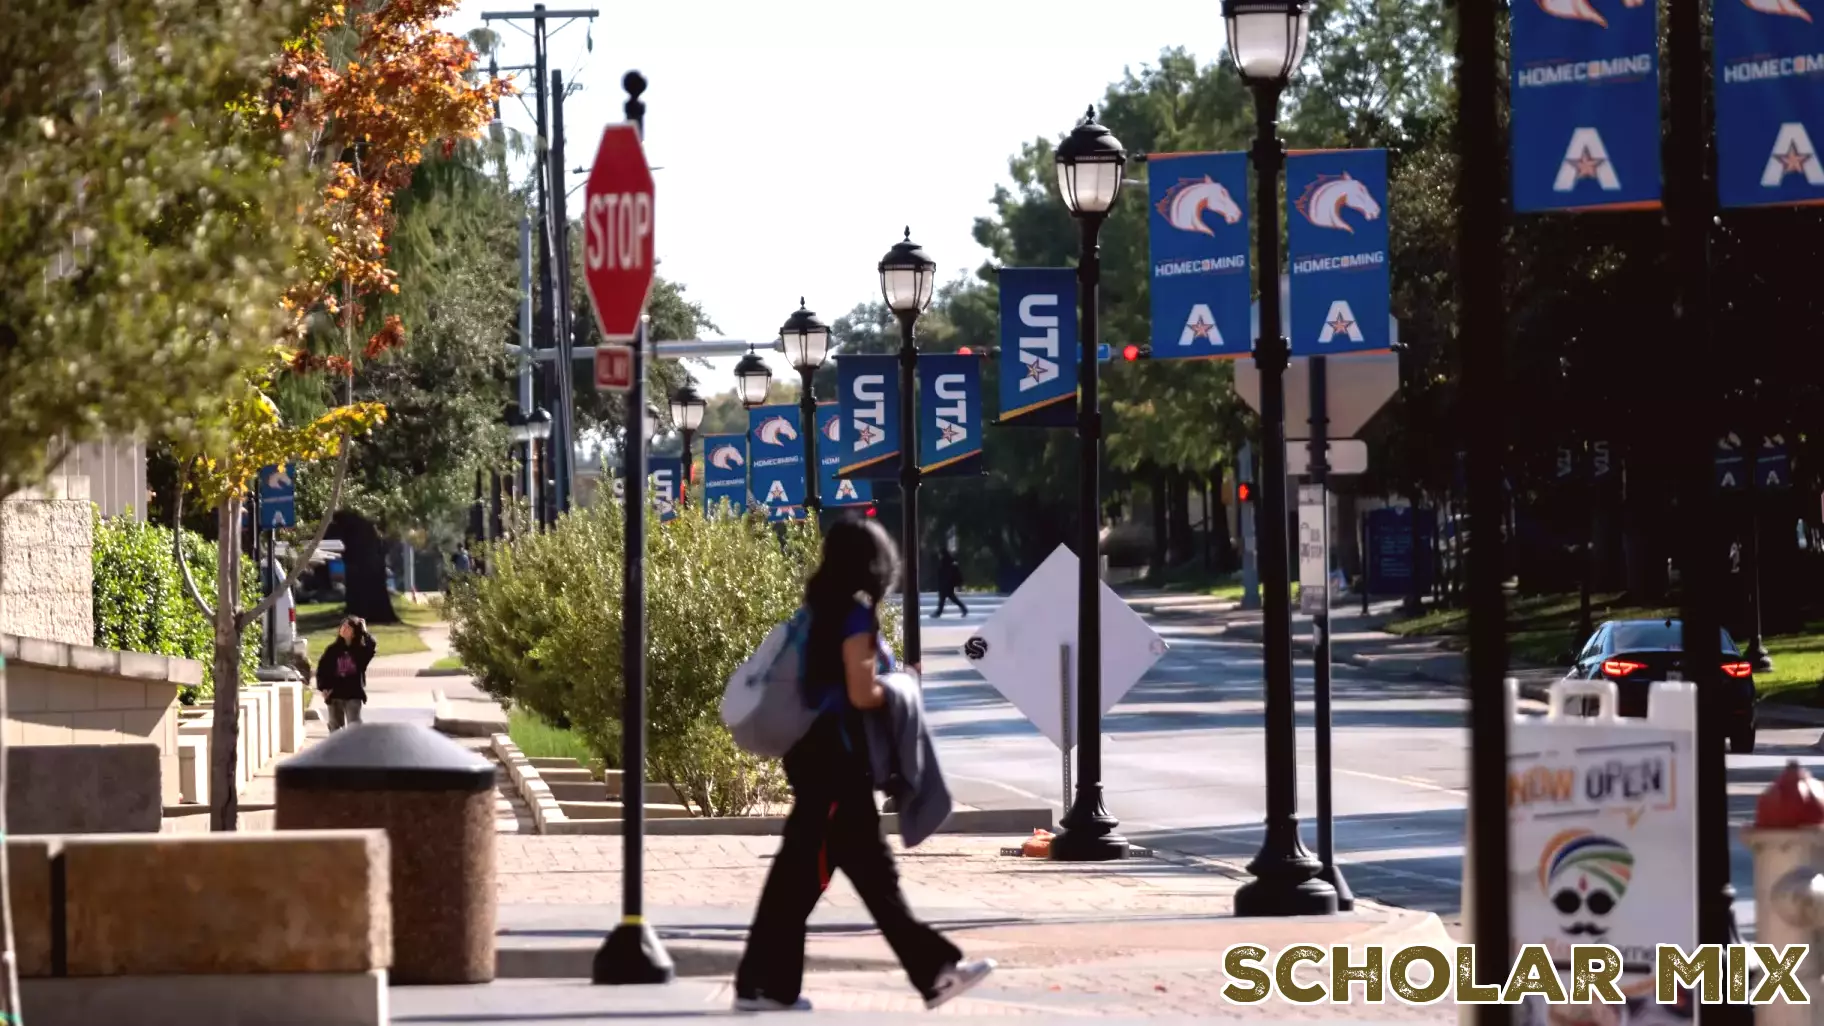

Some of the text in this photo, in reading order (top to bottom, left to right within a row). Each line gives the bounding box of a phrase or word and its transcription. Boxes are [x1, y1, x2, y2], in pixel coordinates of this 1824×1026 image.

[1519, 54, 1651, 87] HOMECOMING
[1553, 127, 1622, 191] A
[587, 192, 651, 271] STOP
[1155, 254, 1245, 277] HOMECOMING
[1293, 251, 1384, 274] HOMECOMING
[1018, 294, 1059, 392] UTA
[1178, 304, 1224, 345] A
[1318, 300, 1364, 343] A
[853, 375, 885, 451] UTA
[935, 374, 967, 450] UTA
[766, 480, 789, 502] A
[1585, 758, 1664, 802] OPEN
